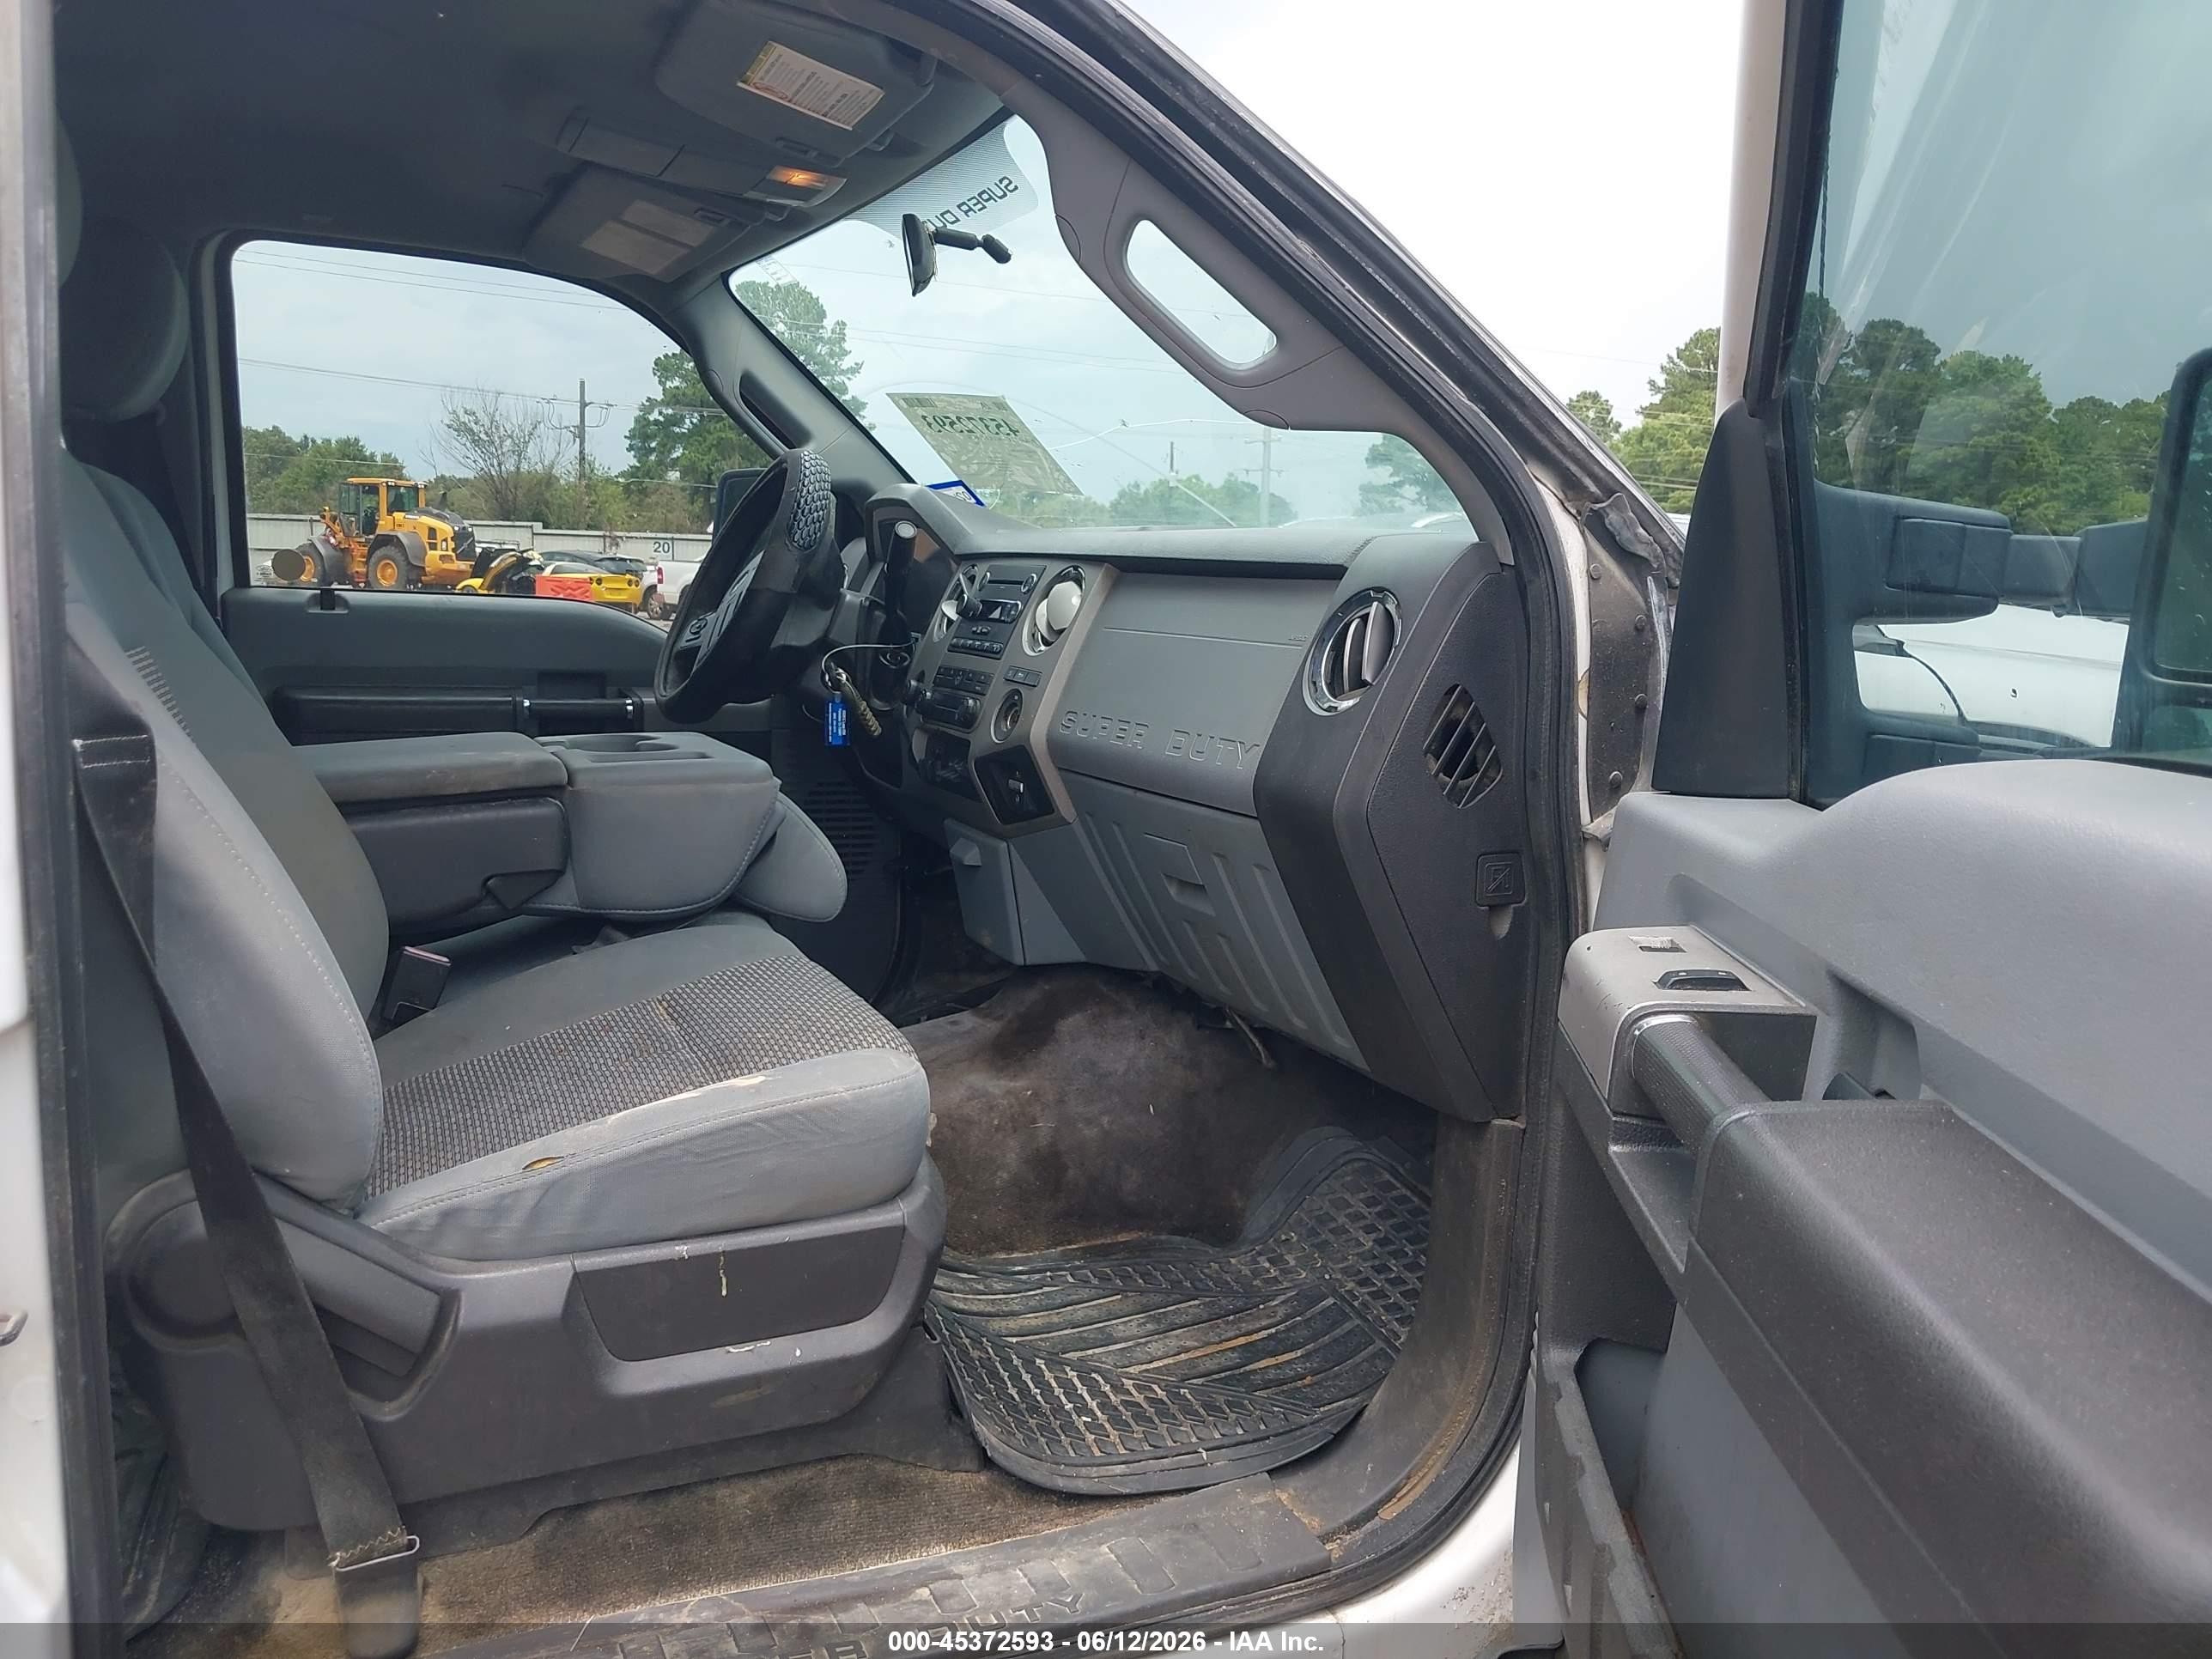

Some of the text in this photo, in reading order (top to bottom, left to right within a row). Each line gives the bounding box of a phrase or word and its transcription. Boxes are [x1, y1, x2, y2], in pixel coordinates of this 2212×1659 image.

[653, 541, 670, 554] 20
[1060, 711, 1260, 769] SUPER DUTY
